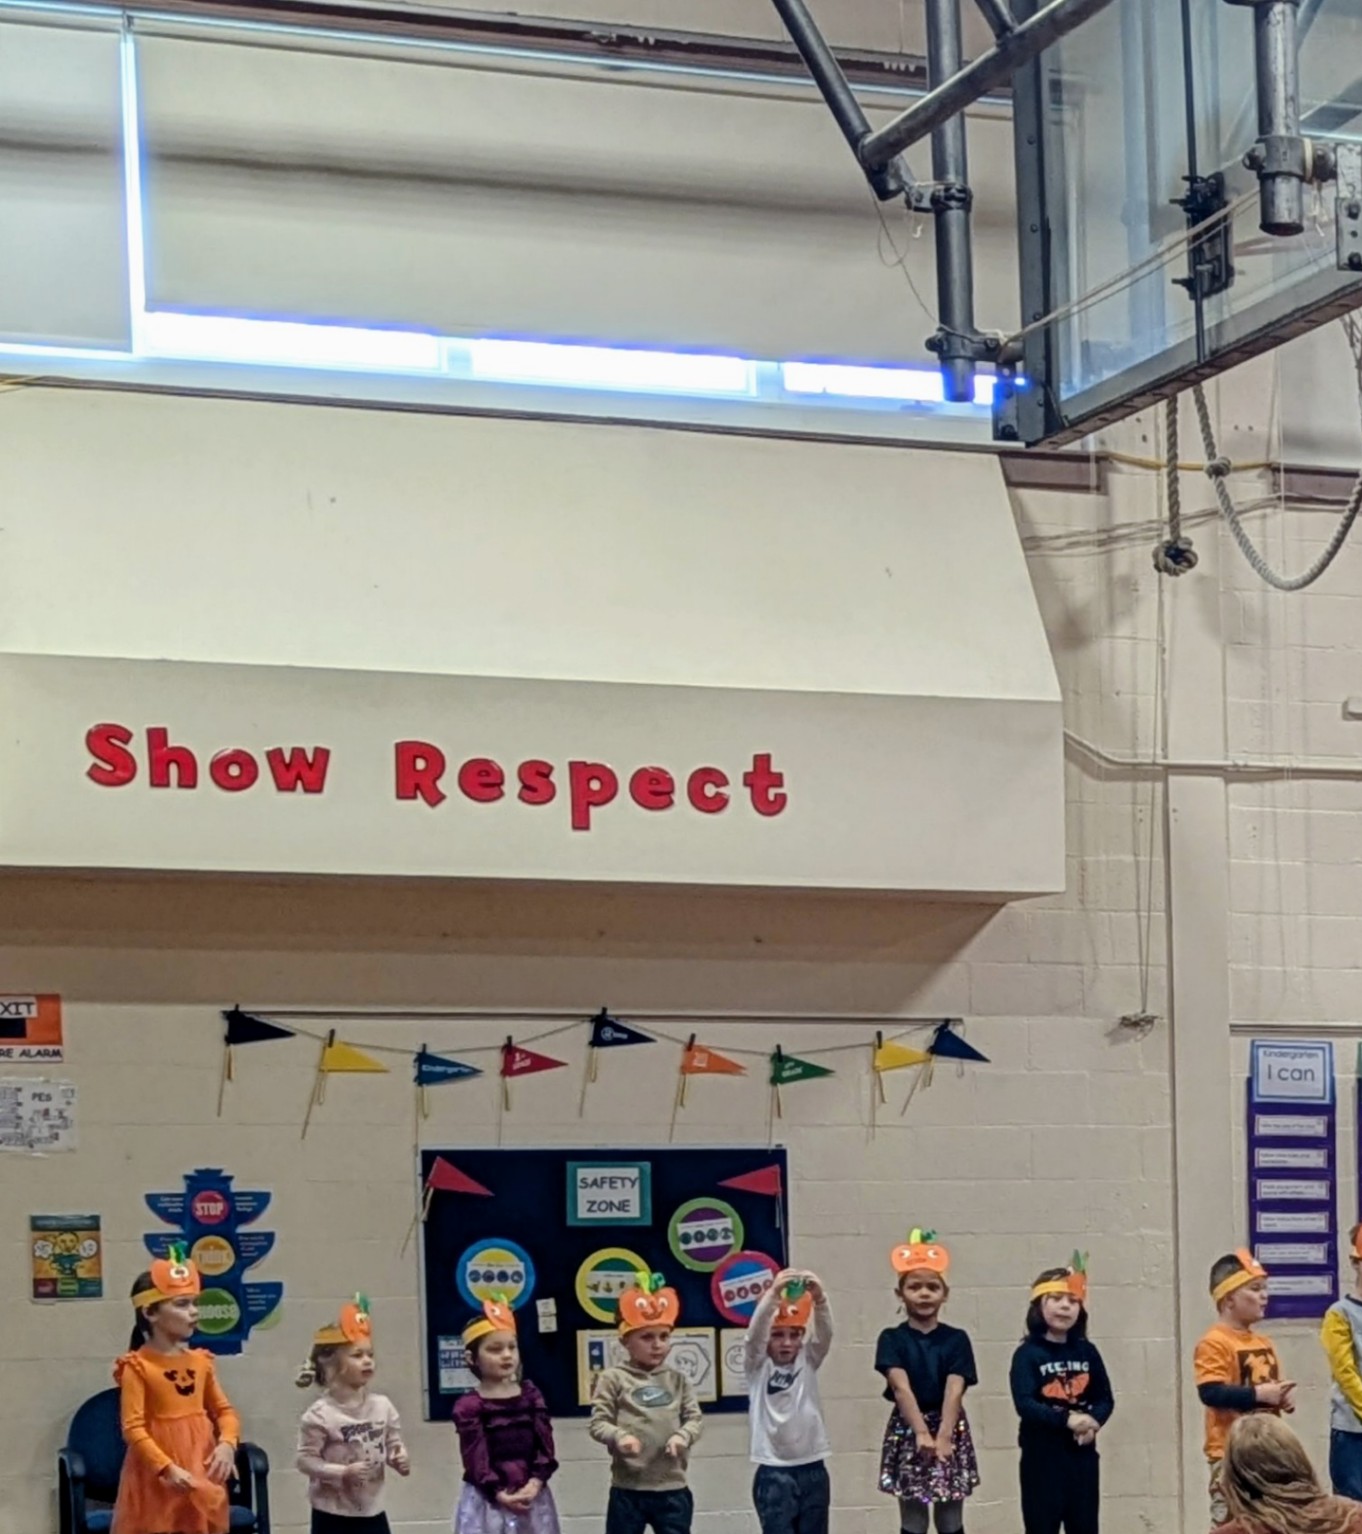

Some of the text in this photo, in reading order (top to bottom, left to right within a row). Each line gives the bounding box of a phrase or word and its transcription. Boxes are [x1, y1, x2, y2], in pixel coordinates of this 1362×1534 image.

[85, 722, 788, 830] Show Respect
[0, 1002, 35, 1015] XIT
[19, 1048, 62, 1058] ALARM
[1263, 1050, 1319, 1060] Kindergarten
[1278, 1067, 1315, 1081] can
[579, 1176, 639, 1189] SAFETY
[195, 1202, 224, 1216] STOP
[586, 1199, 631, 1213] ZONE
